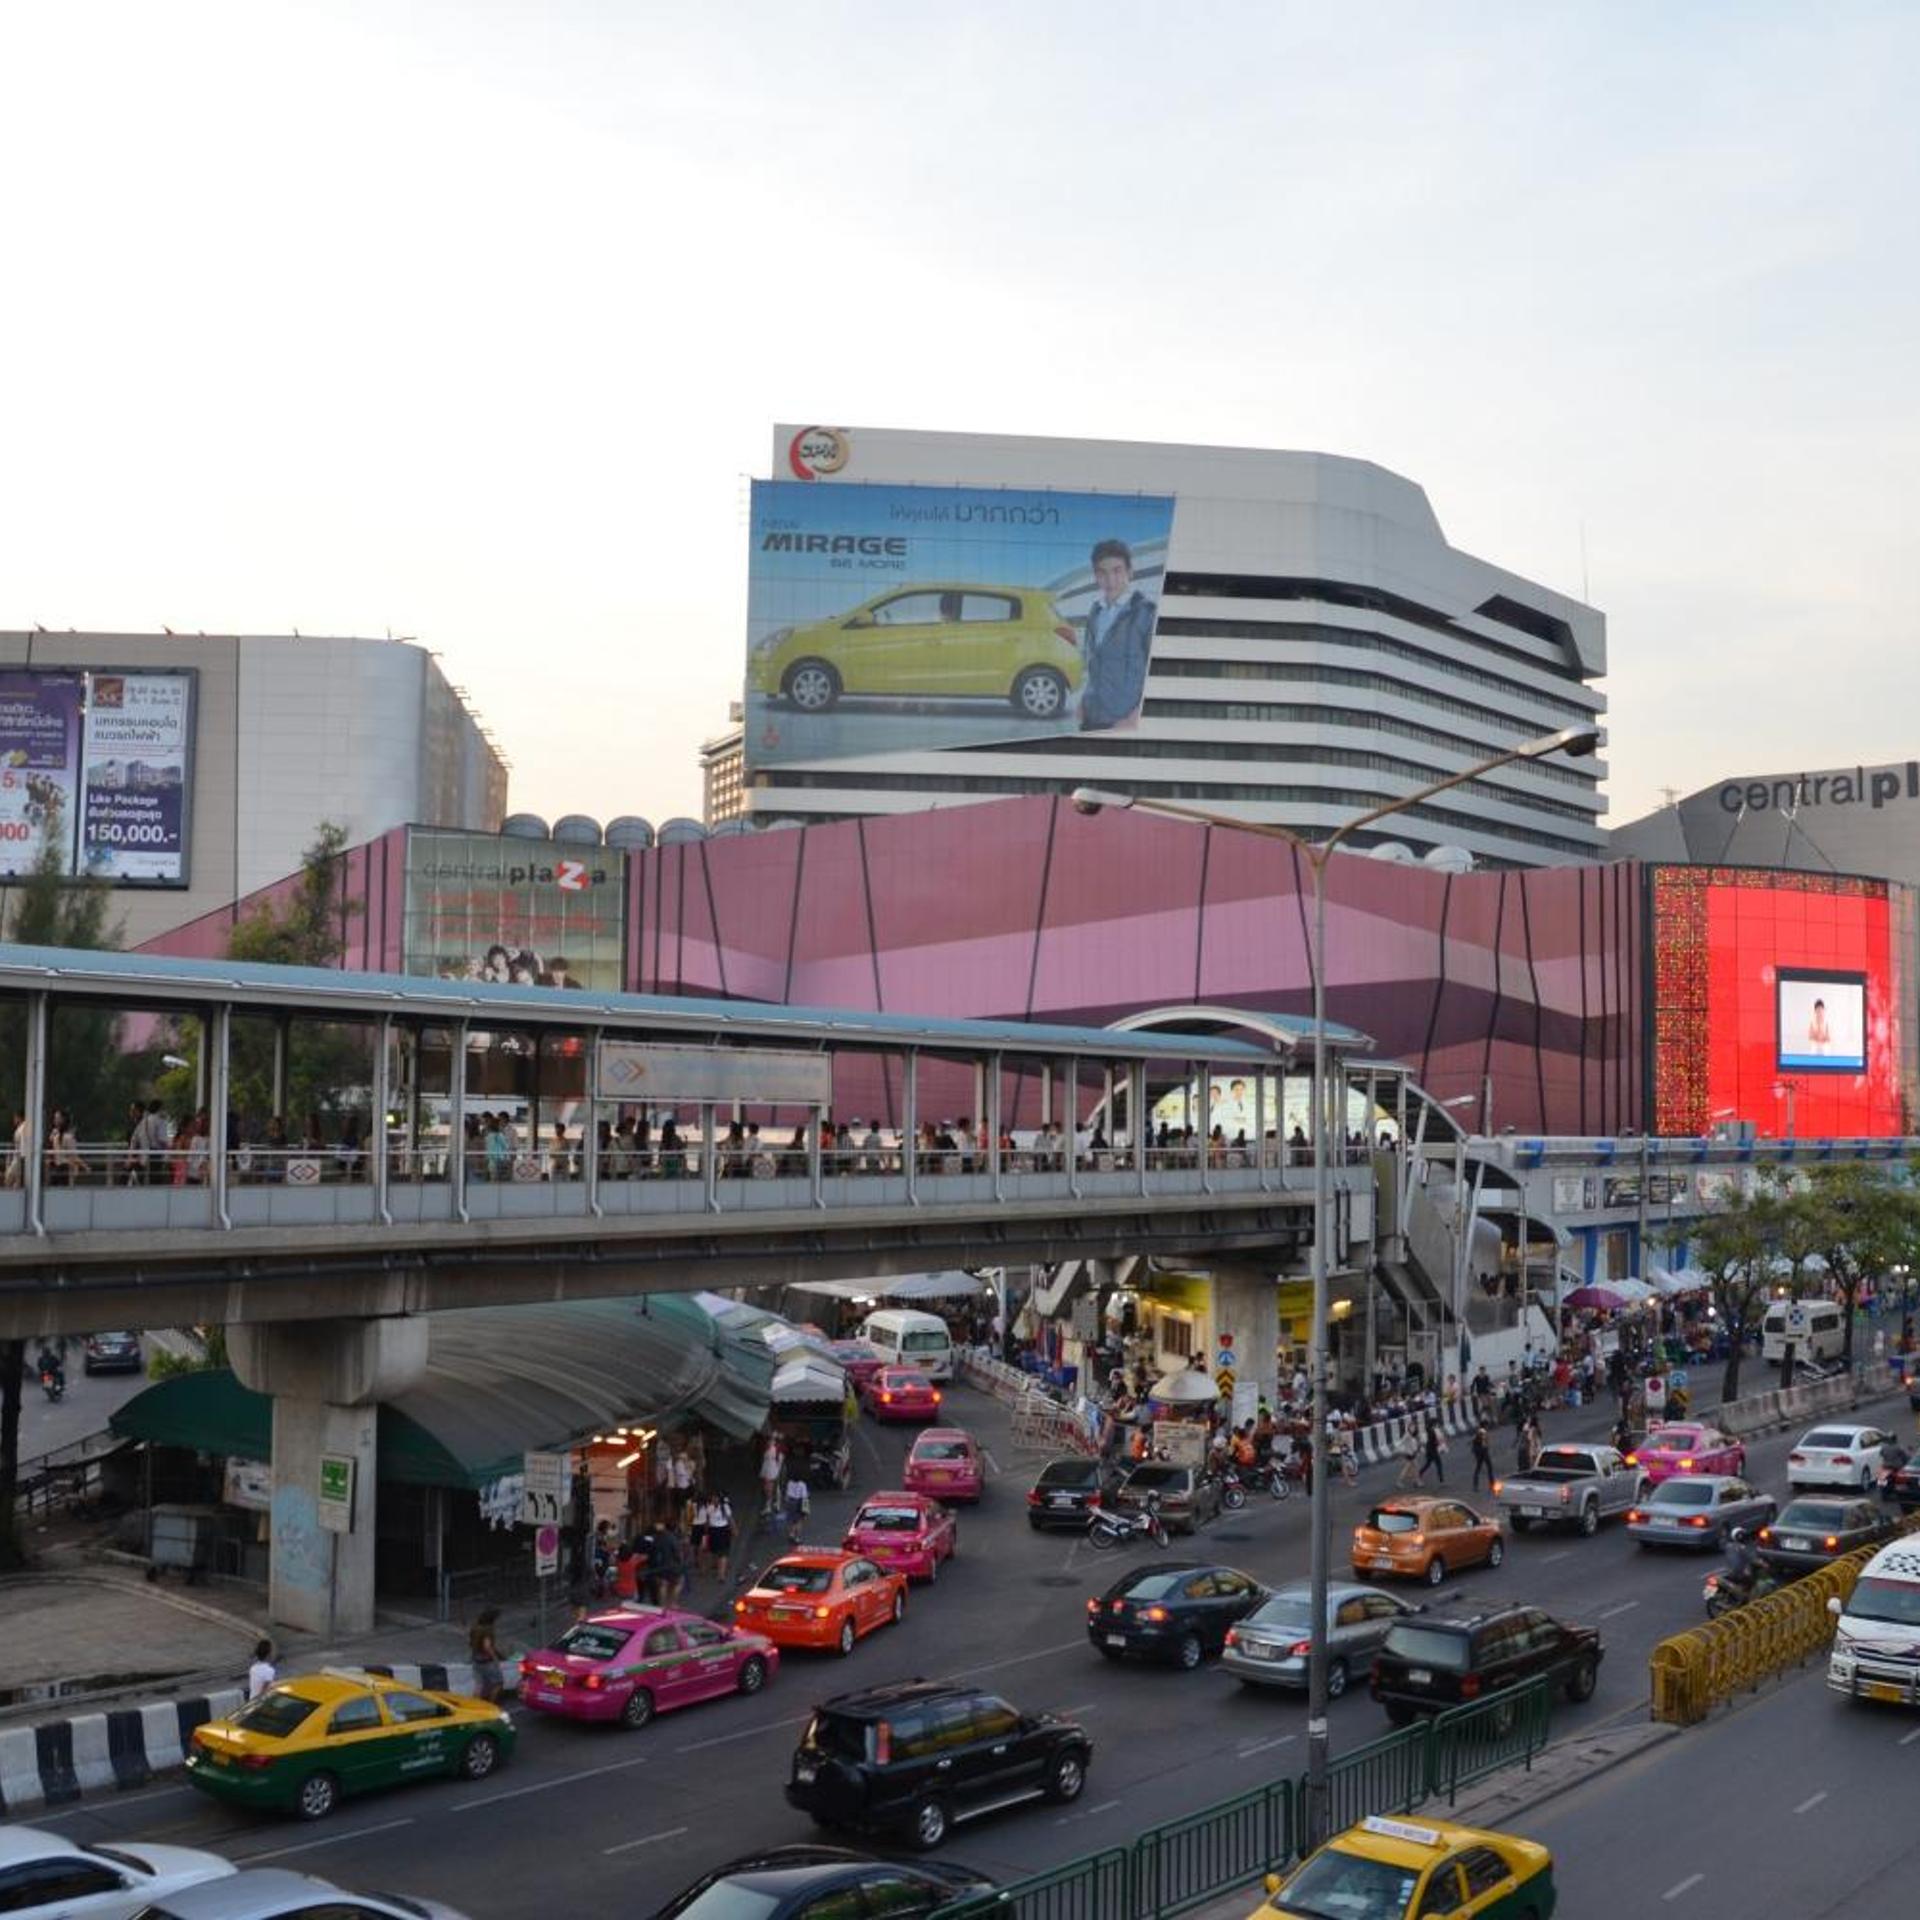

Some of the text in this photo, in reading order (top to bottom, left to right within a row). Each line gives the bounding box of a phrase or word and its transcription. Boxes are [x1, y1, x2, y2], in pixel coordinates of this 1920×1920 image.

[954, 502, 1060, 528] มากกว่า
[761, 533, 908, 557] MIRAGE
[858, 558, 906, 571] MORE
[1719, 761, 1919, 814] centralpl
[114, 794, 159, 807] Package
[88, 824, 178, 845] 150,000.-
